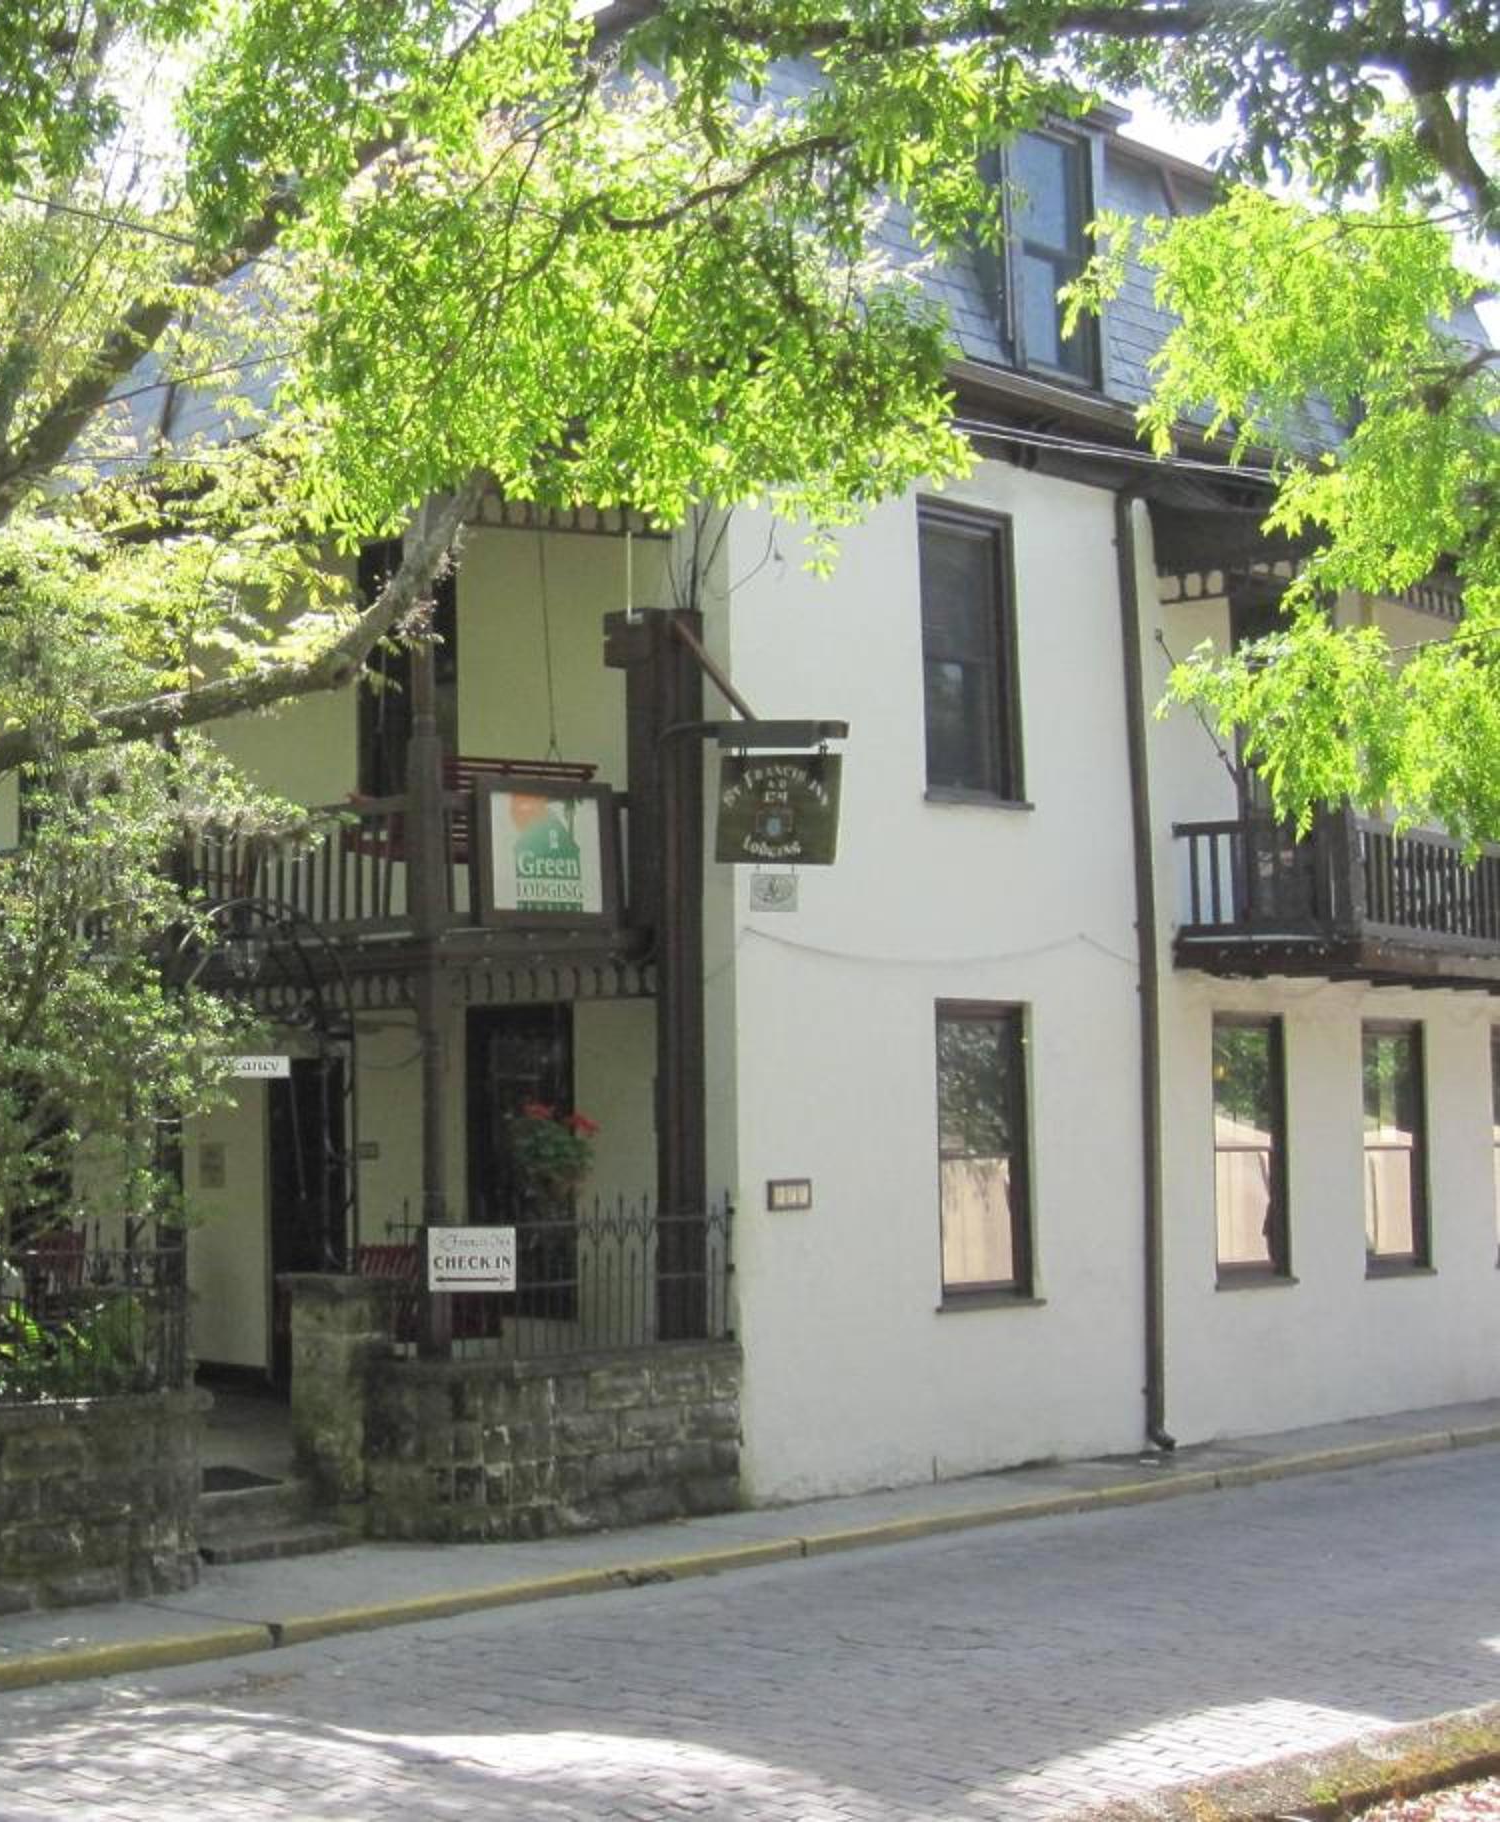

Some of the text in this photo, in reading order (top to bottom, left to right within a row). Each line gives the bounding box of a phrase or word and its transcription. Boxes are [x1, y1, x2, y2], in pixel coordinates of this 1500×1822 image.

[518, 852, 580, 877] Green
[516, 882, 583, 898] LODGING
[433, 1256, 511, 1270] CHECK IN
